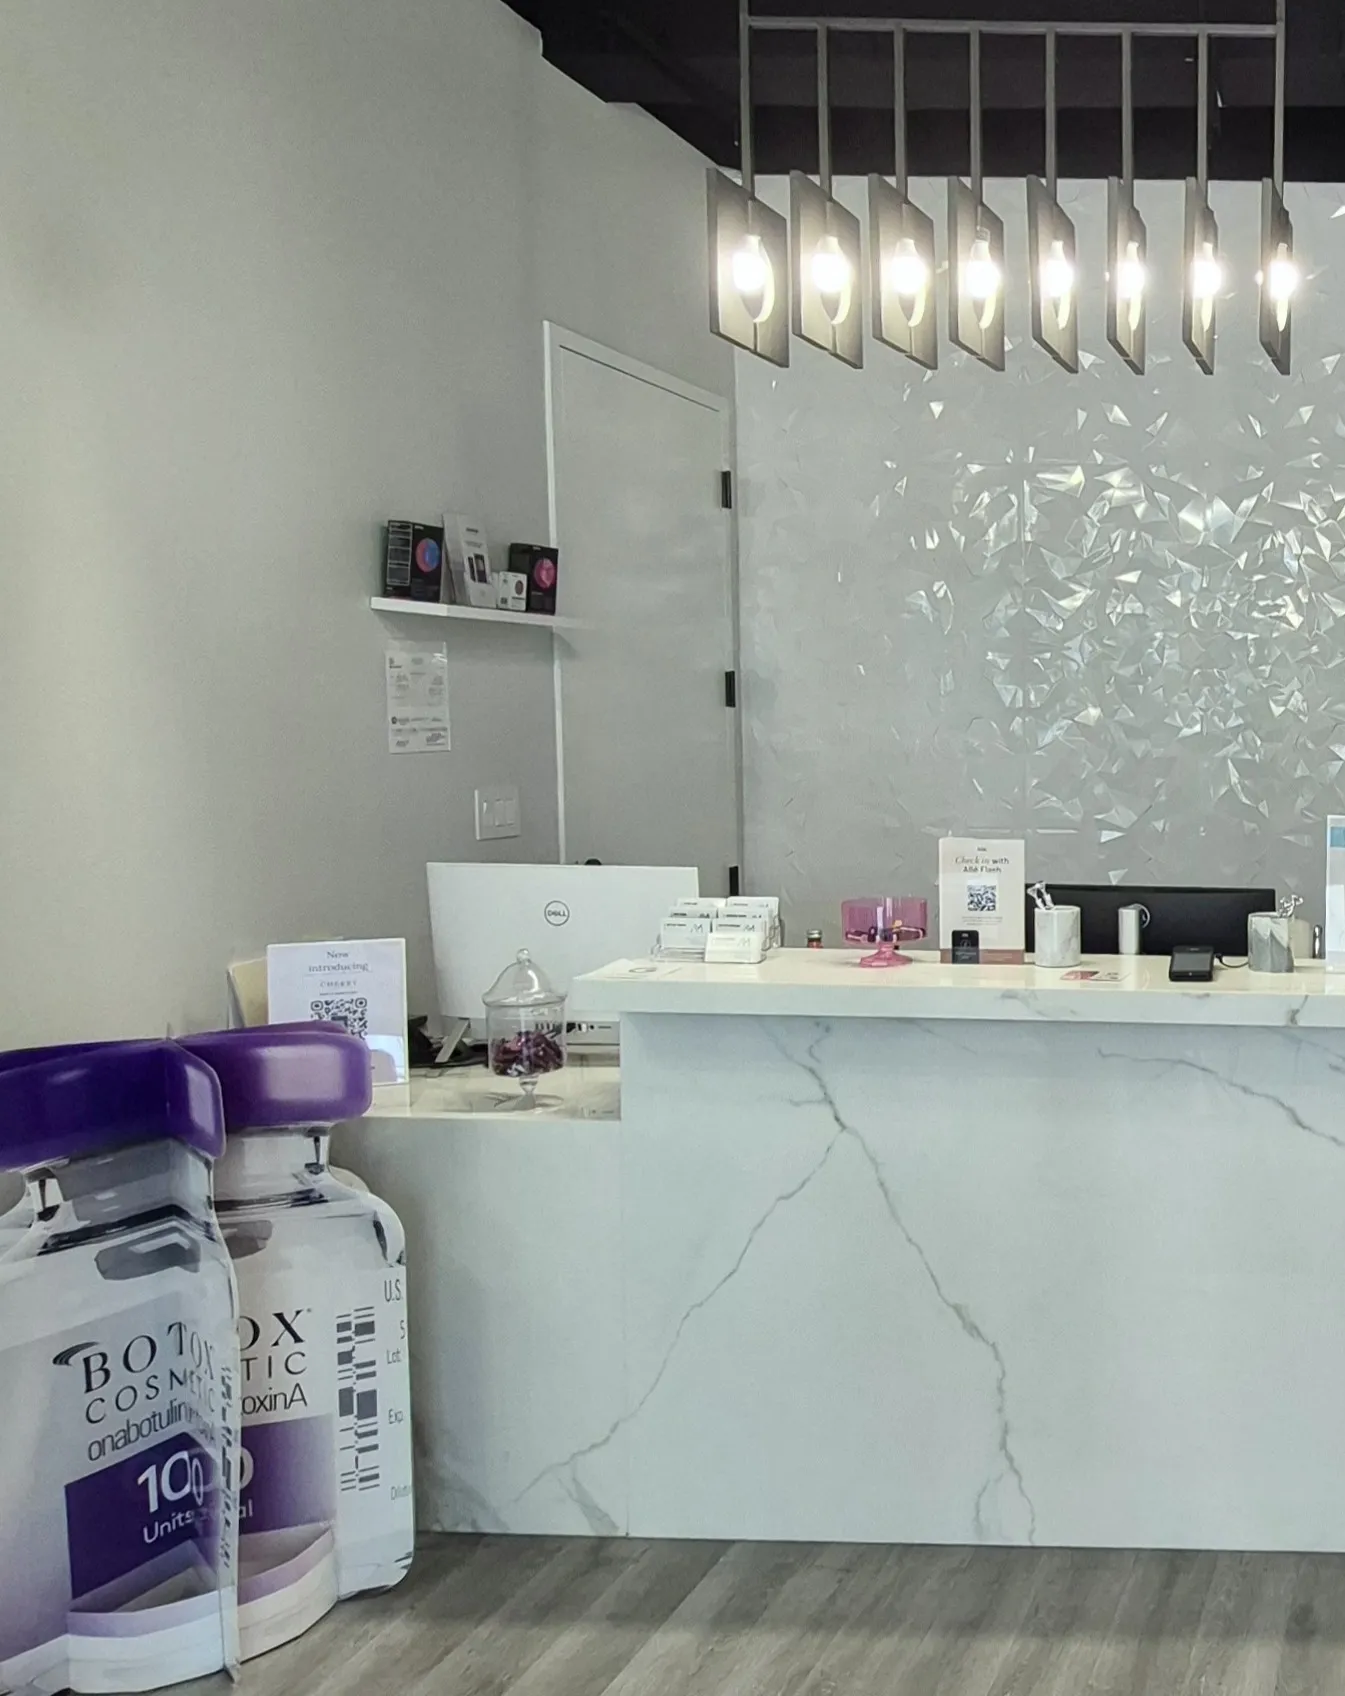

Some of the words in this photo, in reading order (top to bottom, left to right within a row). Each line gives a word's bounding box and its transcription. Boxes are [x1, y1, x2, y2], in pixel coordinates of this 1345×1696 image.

[980, 865, 1002, 873] Flash
[992, 857, 1010, 865] with
[327, 951, 349, 959] Now
[308, 962, 370, 973] introducing
[320, 980, 358, 988] CHERRY
[83, 1321, 214, 1394] BOTOX
[85, 1368, 215, 1424] COSMETIC
[240, 1383, 308, 1415] oxinA
[137, 1450, 203, 1514] 100
[143, 1510, 196, 1544] Units
